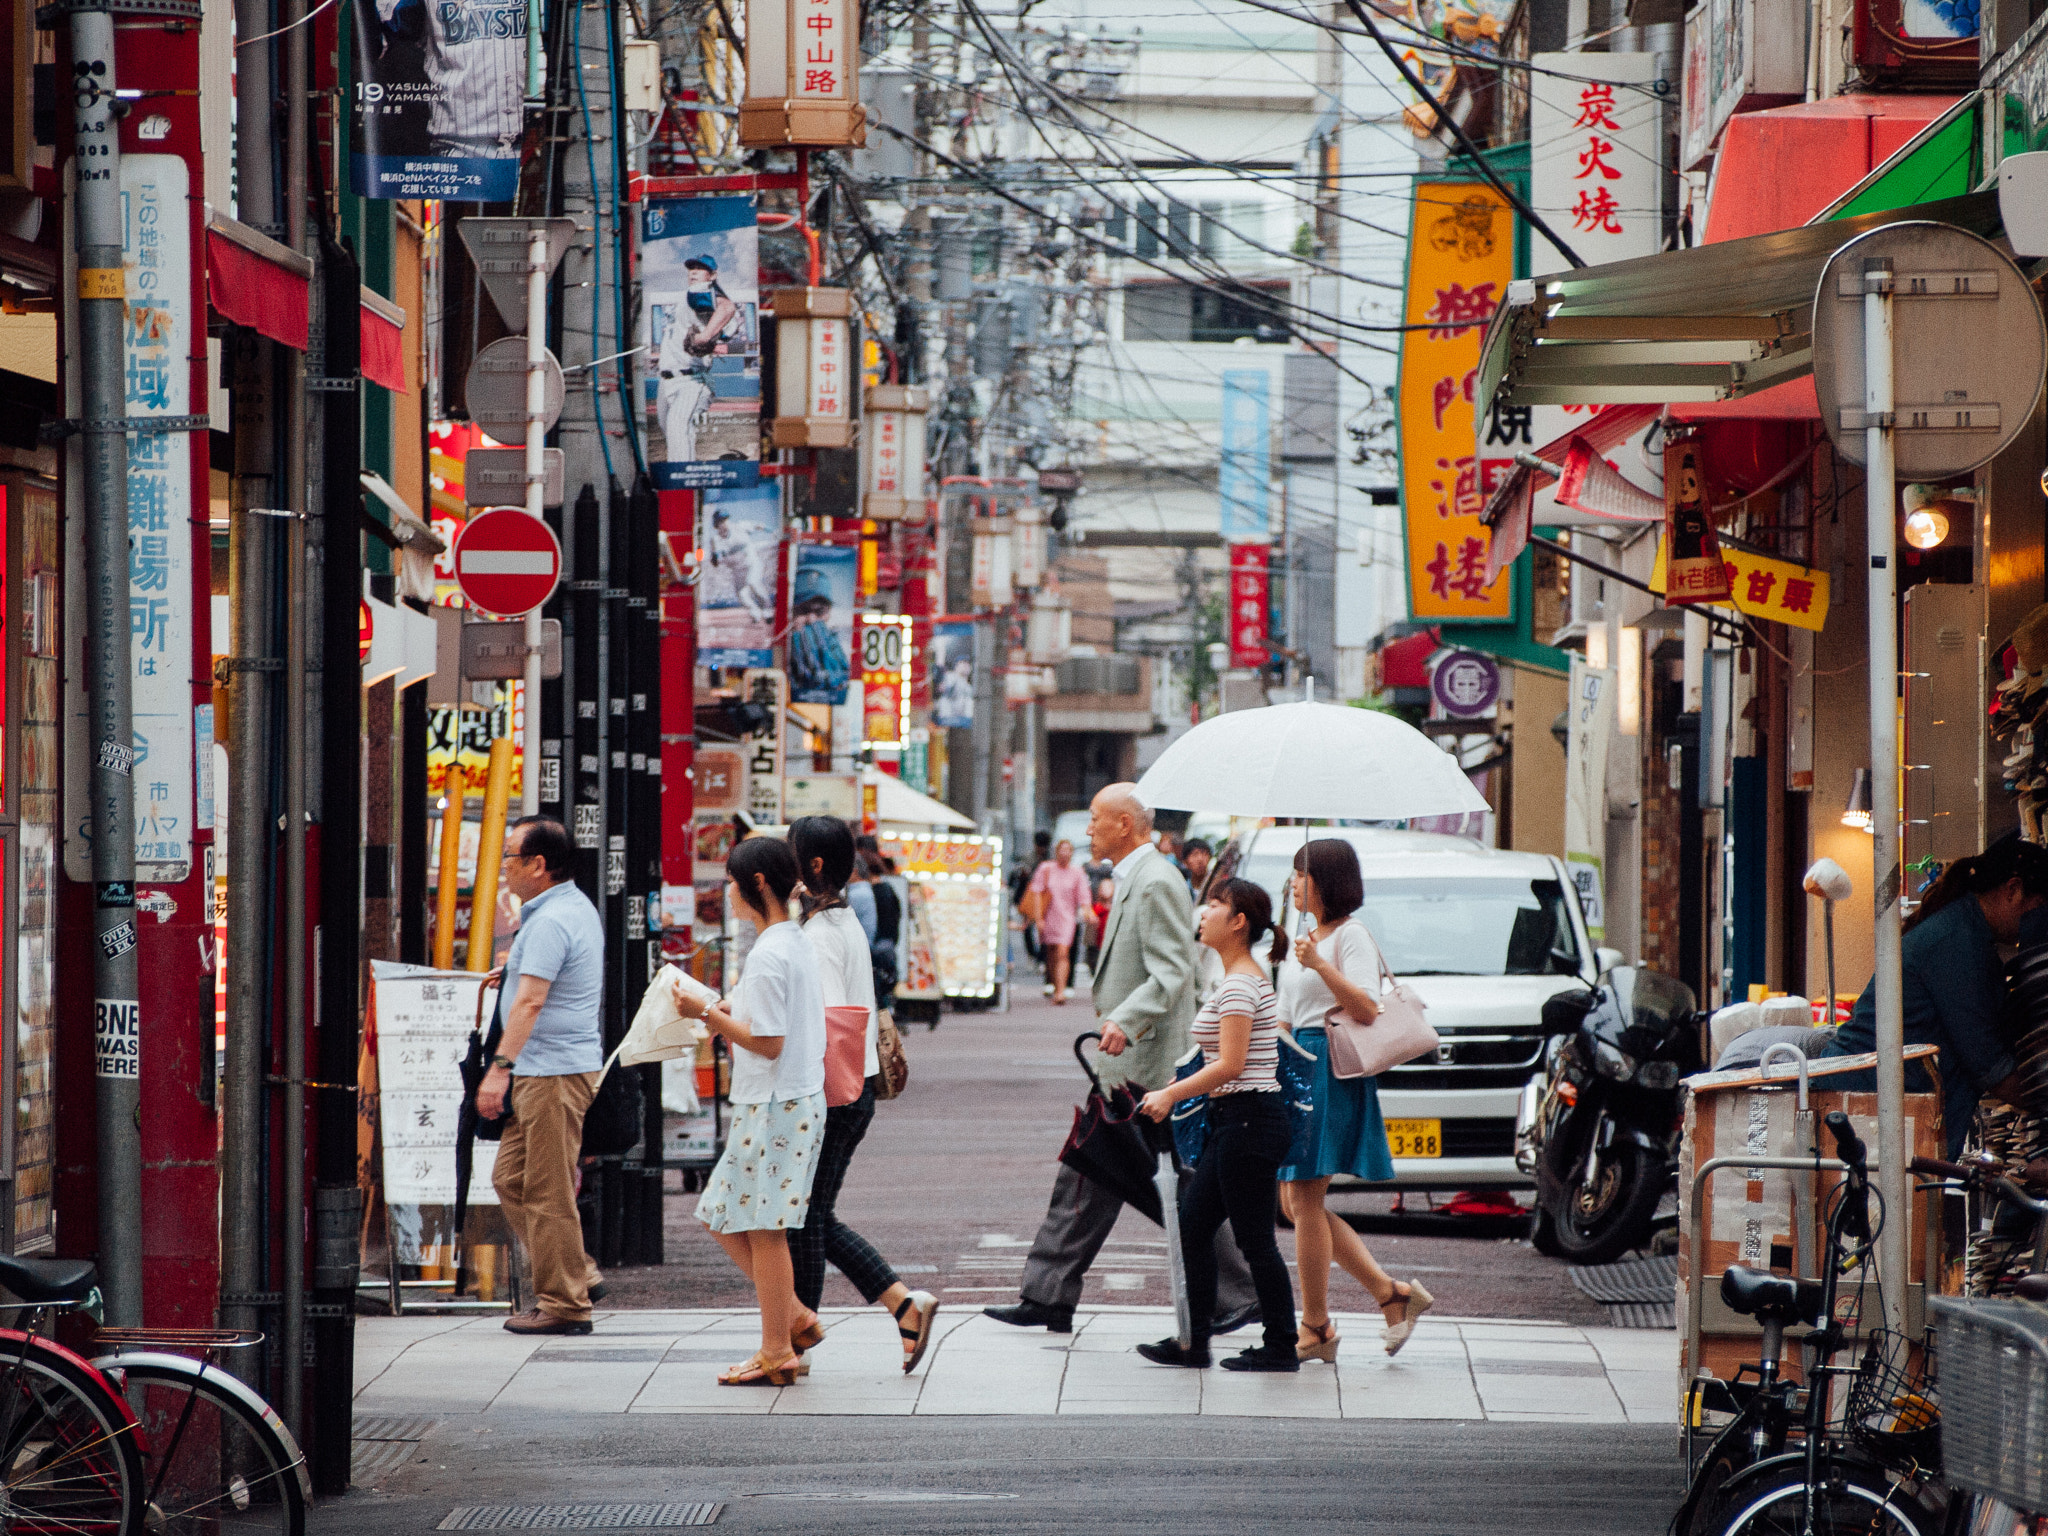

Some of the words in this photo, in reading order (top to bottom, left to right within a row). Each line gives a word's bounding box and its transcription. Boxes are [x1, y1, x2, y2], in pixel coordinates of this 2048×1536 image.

[356, 81, 384, 102] 19
[386, 83, 443, 91] YASUAKI
[865, 628, 901, 667] 80
[102, 923, 132, 946] OVER
[96, 1002, 138, 1036] BNE
